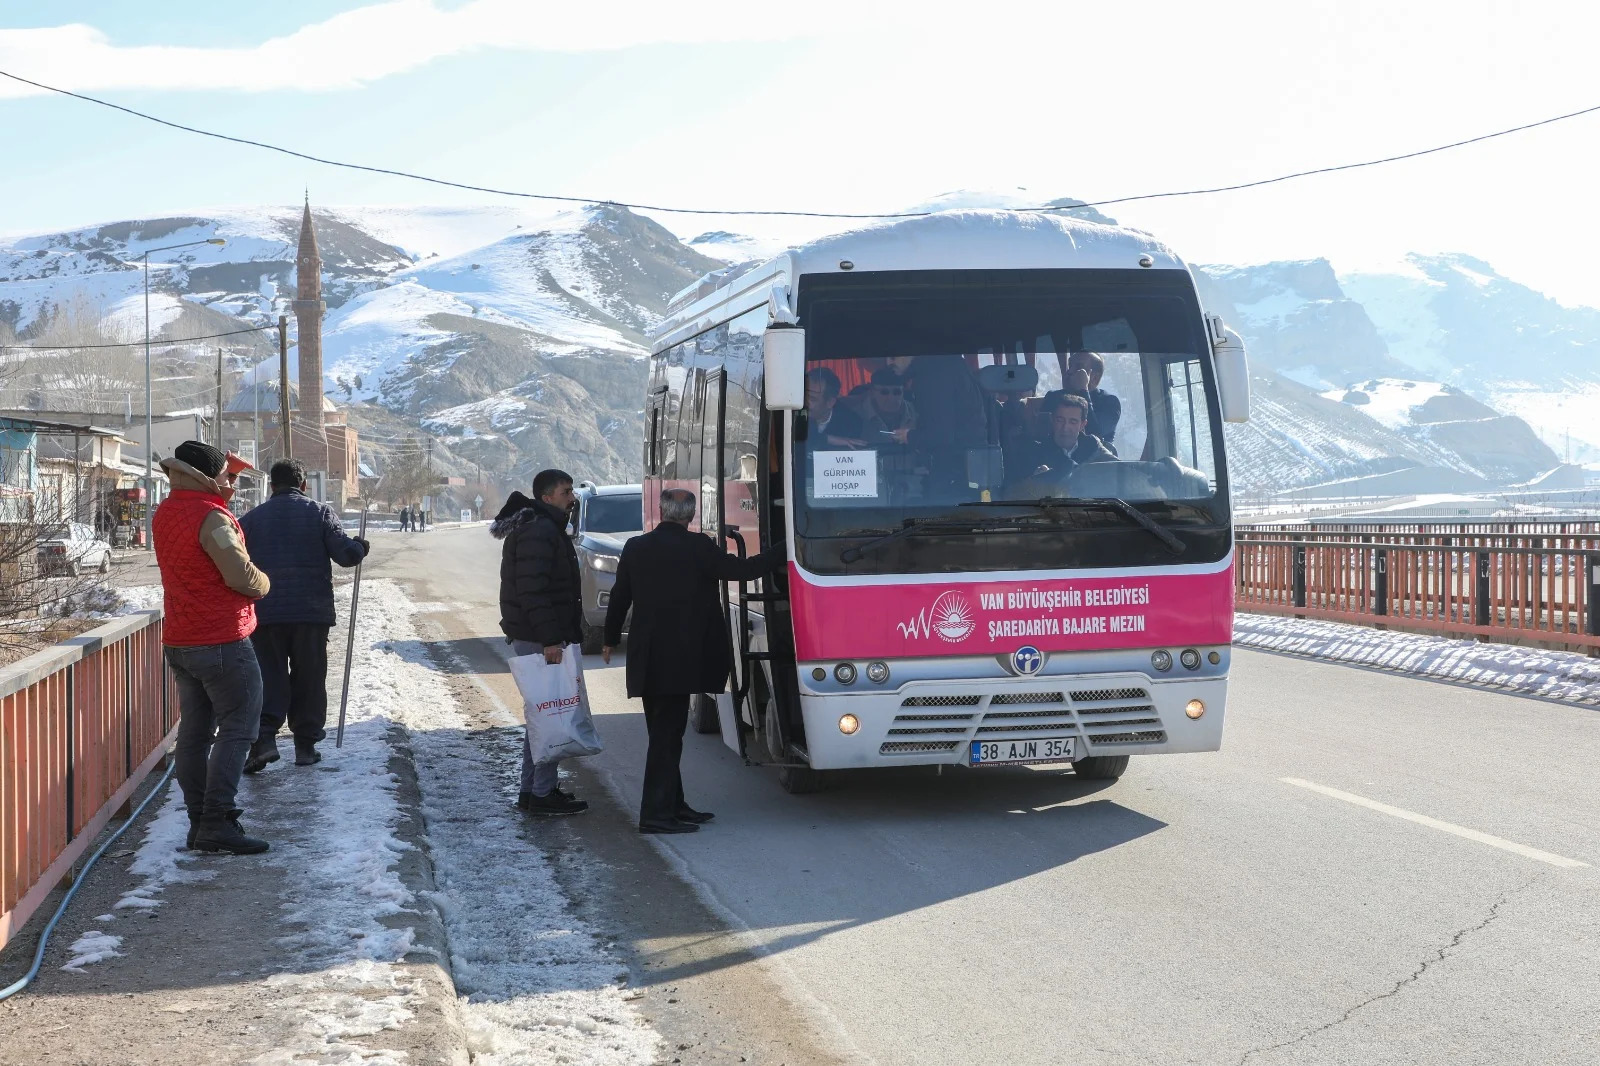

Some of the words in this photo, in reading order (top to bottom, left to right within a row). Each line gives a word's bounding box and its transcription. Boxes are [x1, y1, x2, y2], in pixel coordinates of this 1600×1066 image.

[835, 456, 853, 464] VAN
[823, 468, 866, 477] GÜRPINAR
[831, 482, 859, 491] HOŞAP
[980, 593, 1004, 610] VAN
[1008, 587, 1081, 612] BÜYÜKŞEHİR
[1085, 584, 1149, 606] BELEDİYESİ
[988, 615, 1059, 641] ŞAREDARİYA
[1063, 617, 1106, 635] BAJARE
[1110, 615, 1145, 632] MEZIN
[981, 744, 998, 760] 38
[1009, 742, 1037, 759] AJN
[1045, 740, 1071, 756] 354
